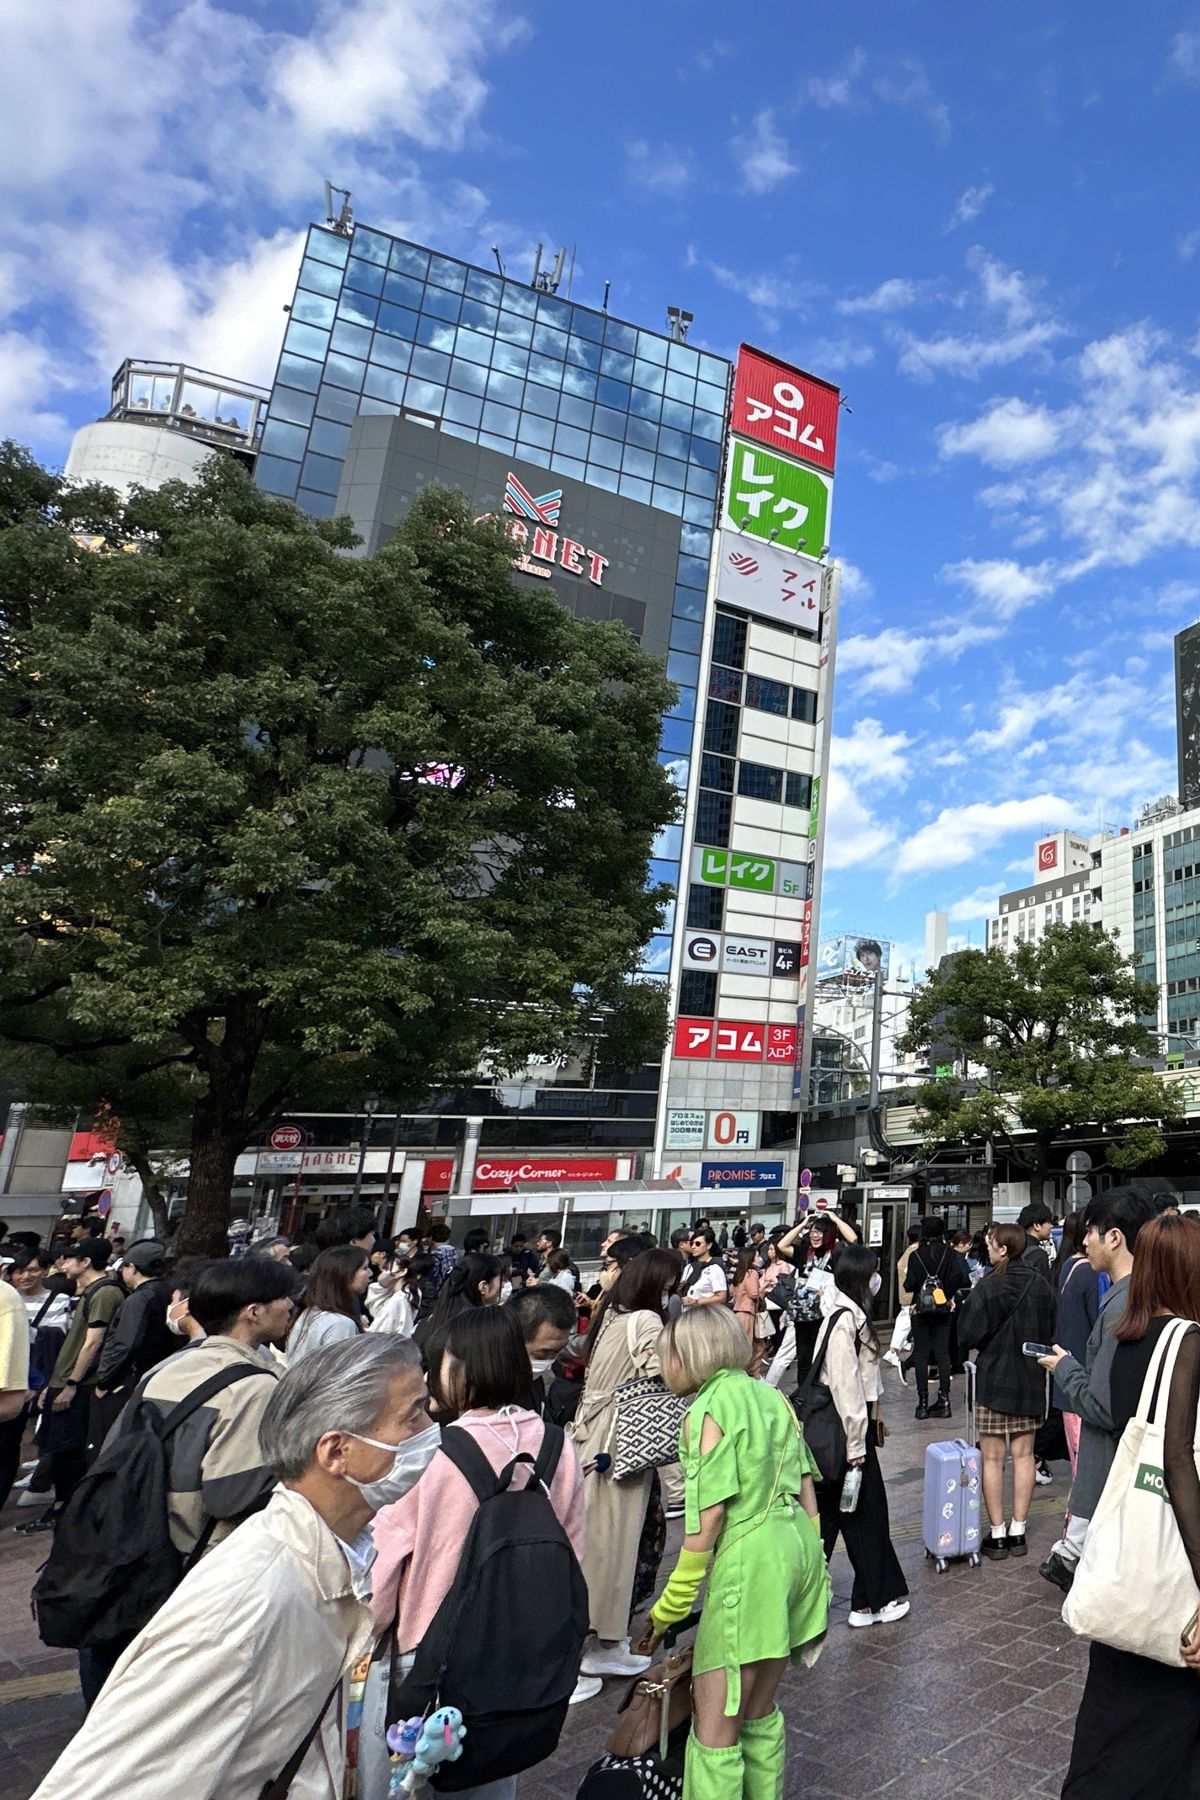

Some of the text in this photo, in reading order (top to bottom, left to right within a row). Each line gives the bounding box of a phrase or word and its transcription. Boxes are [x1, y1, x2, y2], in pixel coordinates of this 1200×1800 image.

[746, 396, 825, 453] アコム
[473, 511, 610, 586] GNET
[706, 853, 771, 883] レイク
[782, 879, 800, 894] 5F
[725, 945, 768, 958] EAST
[775, 954, 794, 970] 4F
[687, 1027, 763, 1053] アコム
[773, 1029, 792, 1041] 3F
[767, 1046, 786, 1059] 入口
[714, 1112, 750, 1145] 0円
[475, 1163, 518, 1184] Cozy
[518, 1164, 567, 1179] Corner
[707, 1169, 757, 1181] PROMISE
